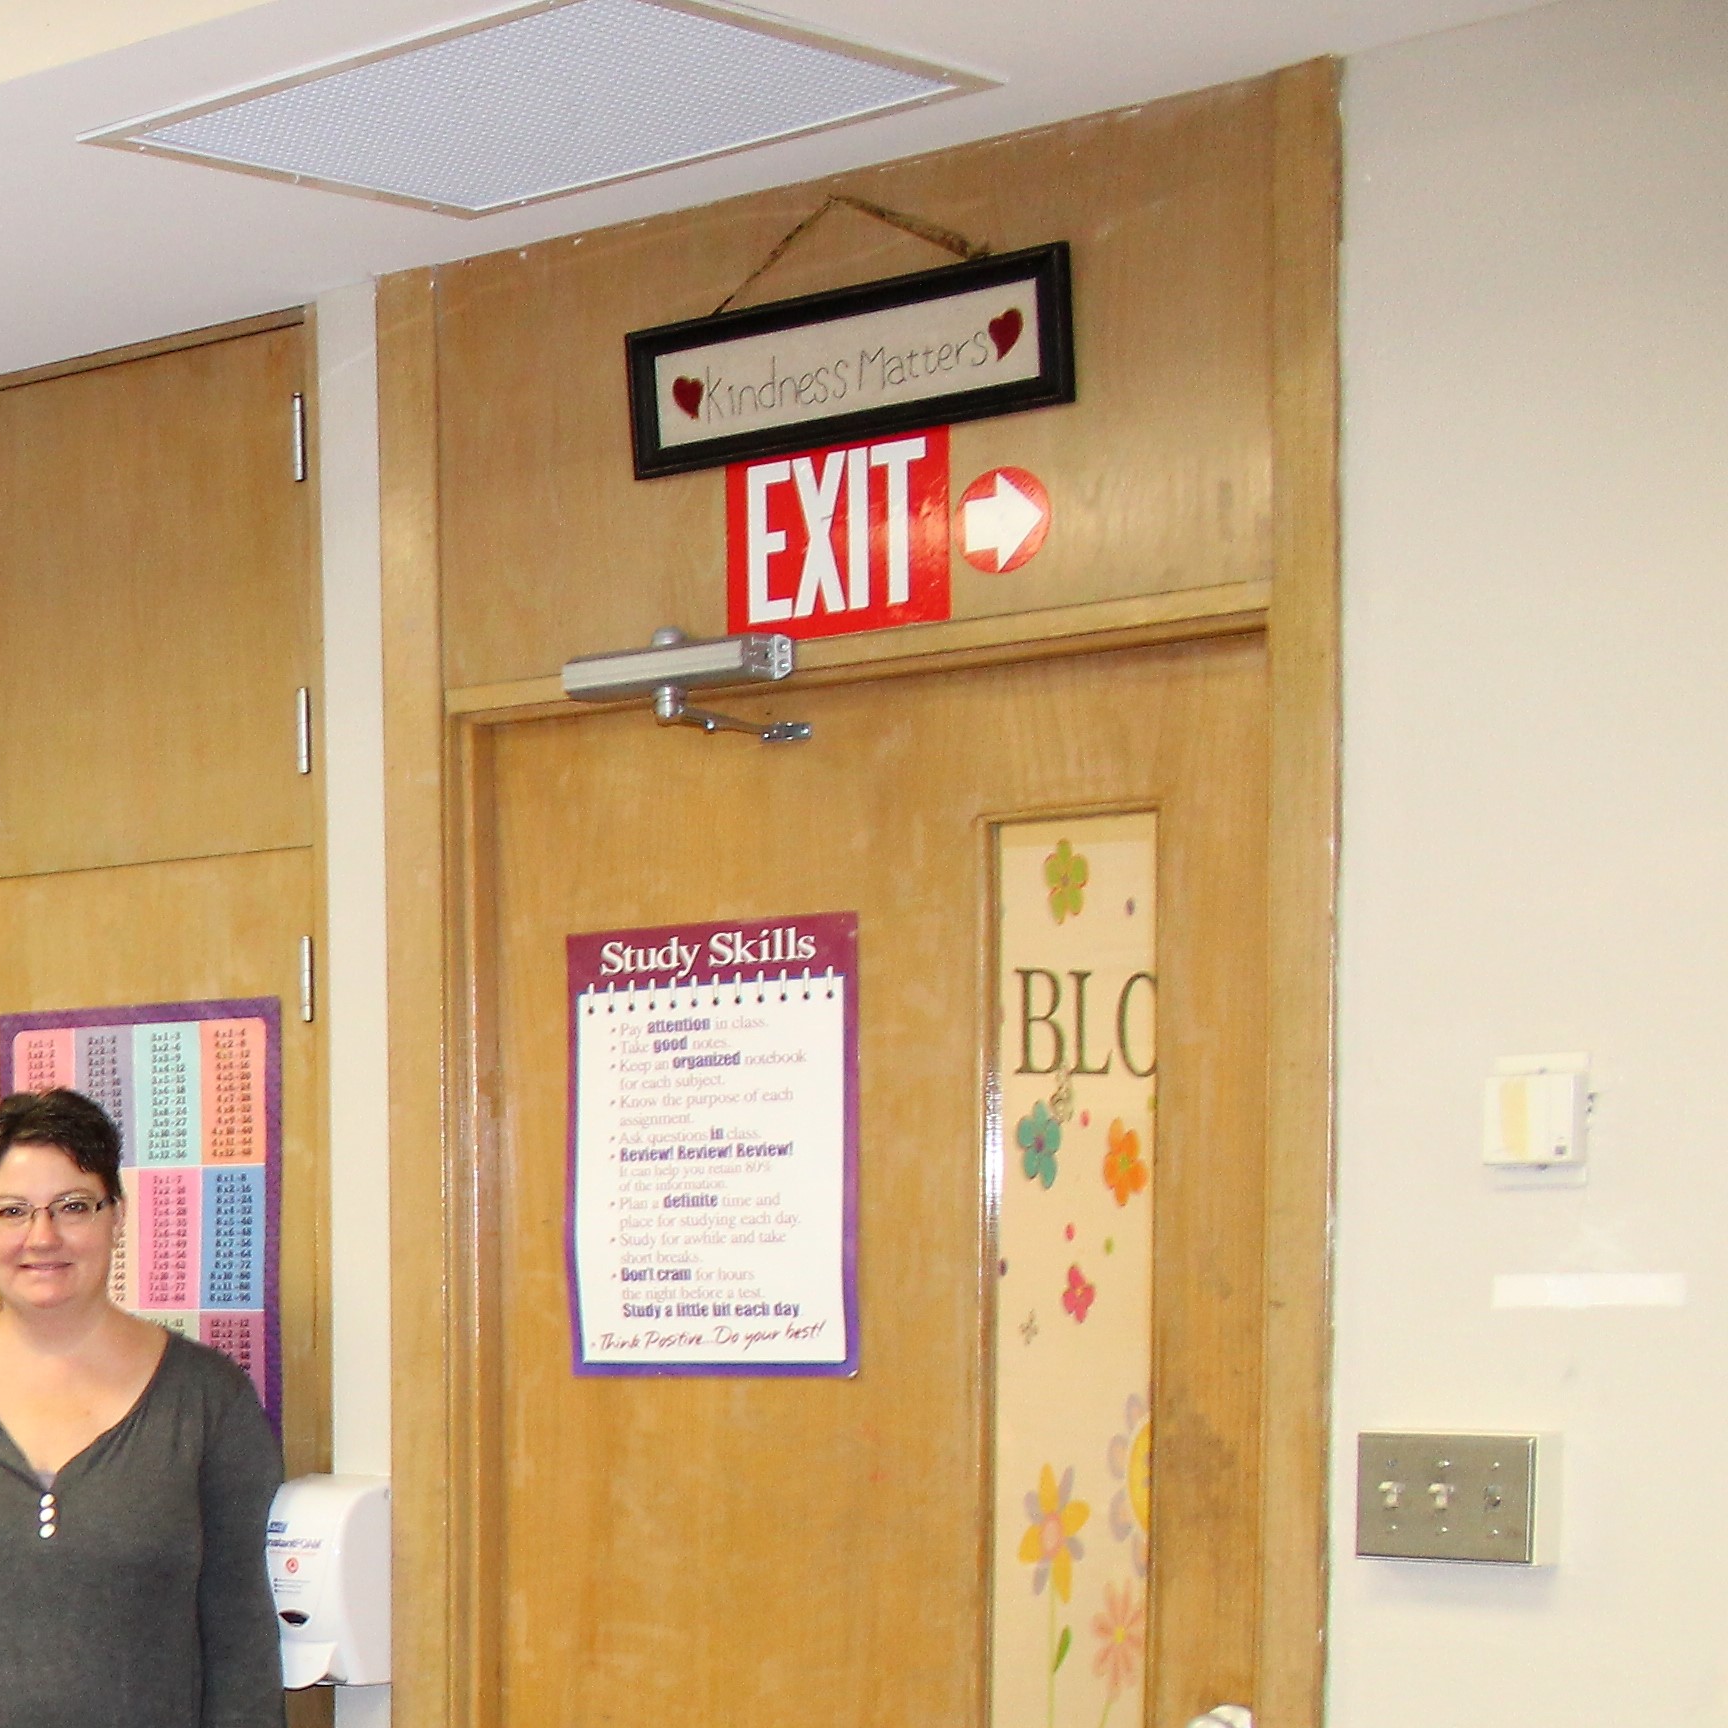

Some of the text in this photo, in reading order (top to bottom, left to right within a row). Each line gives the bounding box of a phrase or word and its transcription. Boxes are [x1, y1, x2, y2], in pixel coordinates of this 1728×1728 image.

[704, 330, 990, 424] Kindness Matters
[747, 436, 926, 625] EXIT
[600, 926, 818, 979] Study Skills
[648, 1017, 710, 1034] attention
[653, 1036, 688, 1054] good
[620, 1059, 651, 1074] Keep
[673, 1051, 741, 1069] organized
[745, 1050, 806, 1065] notebook
[621, 1077, 638, 1090] for
[642, 1075, 671, 1089] each
[620, 1087, 793, 1109] Know the purpose of each
[619, 1132, 642, 1144] Ask
[648, 1131, 707, 1146] questions
[710, 1126, 724, 1140] in
[621, 1142, 794, 1162] Review! Review! Review!
[631, 1167, 651, 1177] can
[655, 1164, 679, 1180] help
[682, 1165, 705, 1177] you
[619, 1180, 632, 1191] of
[635, 1180, 652, 1190] the
[619, 1197, 648, 1210] Plan
[663, 1194, 718, 1209] definite
[722, 1194, 752, 1207] time
[755, 1194, 780, 1207] and
[620, 1216, 653, 1232] place
[657, 1214, 676, 1228] for
[680, 1214, 737, 1230] studying
[740, 1211, 772, 1225] each
[620, 1231, 786, 1250] Study for awhile and take
[620, 1251, 653, 1265] short
[621, 1267, 755, 1282] Don't cram for hours
[622, 1288, 643, 1300] the
[646, 1286, 676, 1303] night
[680, 1285, 723, 1299] before
[623, 1302, 661, 1319] Study
[664, 1305, 673, 1317] a
[676, 1303, 709, 1317] little
[713, 1302, 731, 1316] bit
[734, 1301, 770, 1316] each
[600, 1333, 639, 1350] Think
[744, 1332, 780, 1351] your
[785, 1320, 827, 1338] best!
